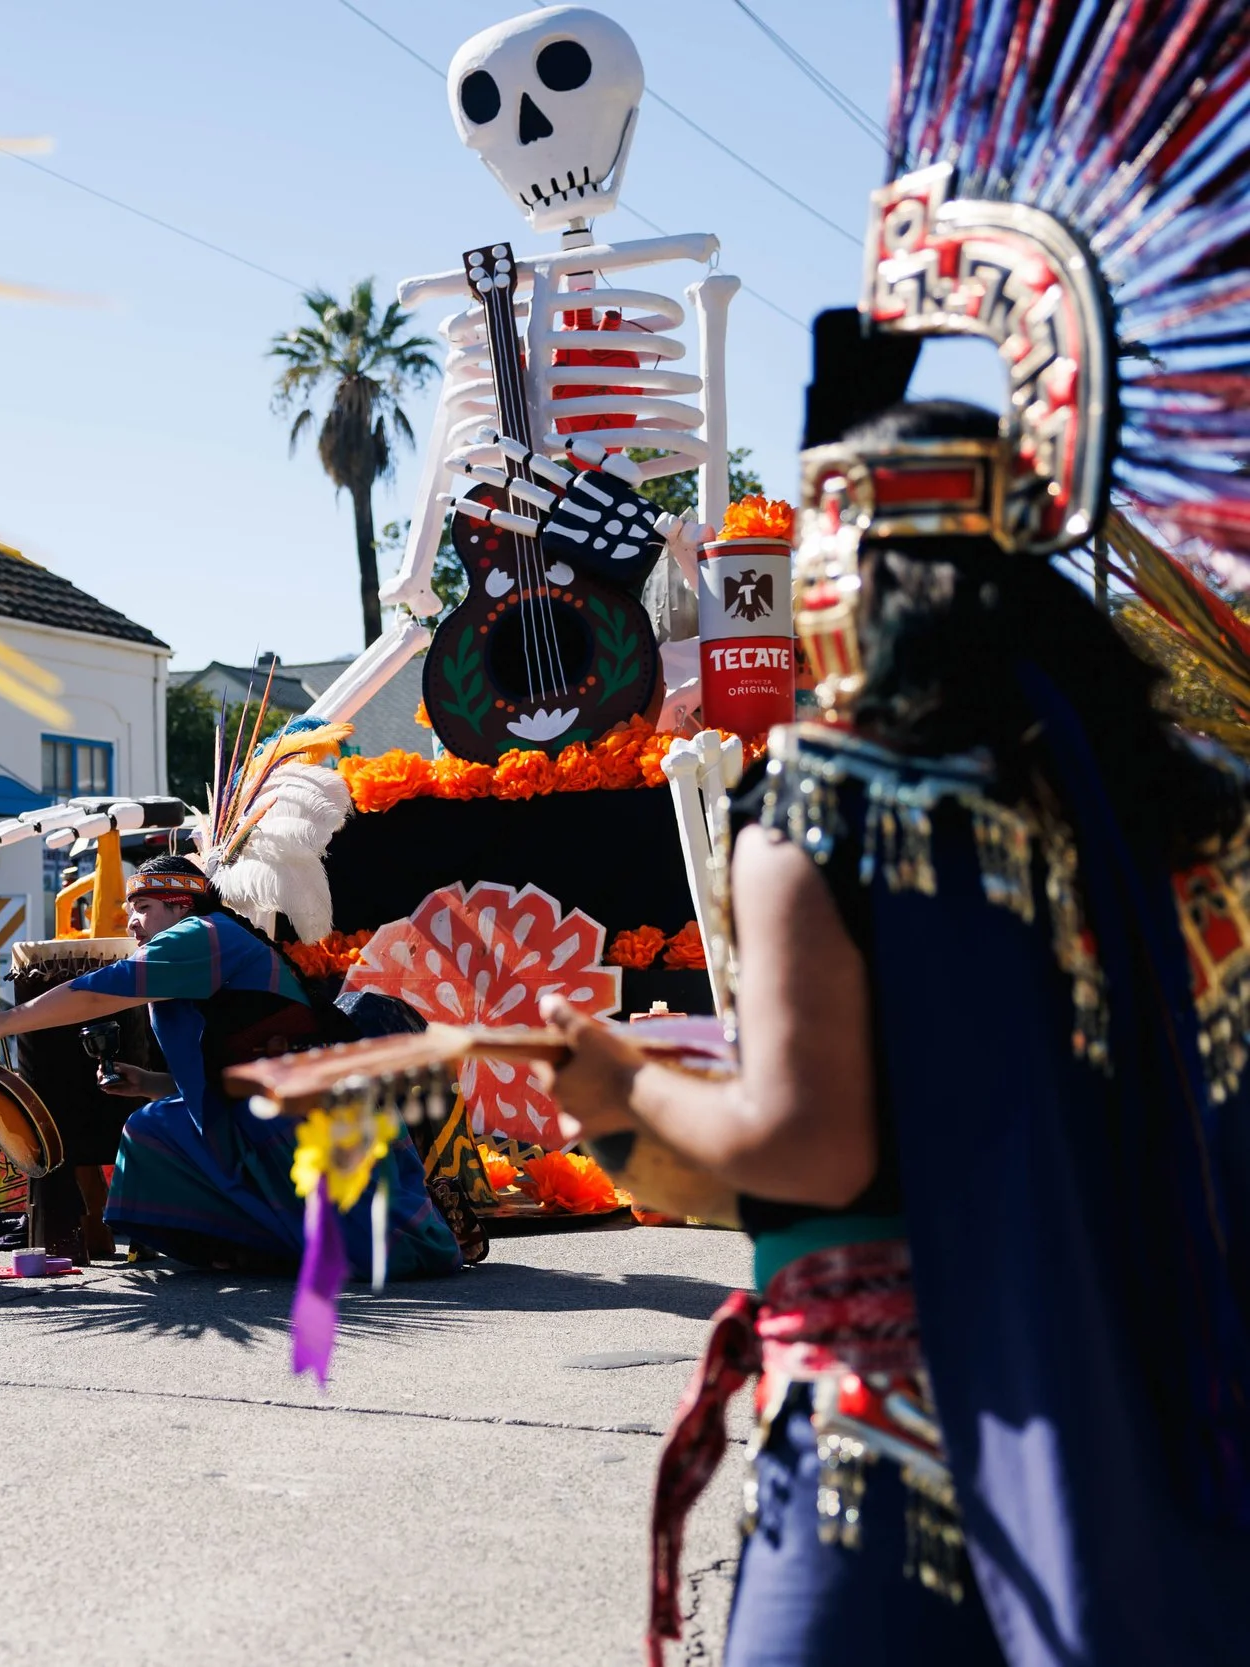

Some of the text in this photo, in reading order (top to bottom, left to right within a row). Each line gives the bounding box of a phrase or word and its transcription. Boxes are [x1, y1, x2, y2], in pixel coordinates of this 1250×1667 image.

[738, 584, 756, 605] T
[710, 648, 789, 671] TECATE
[728, 685, 780, 696] ORIGINAL
